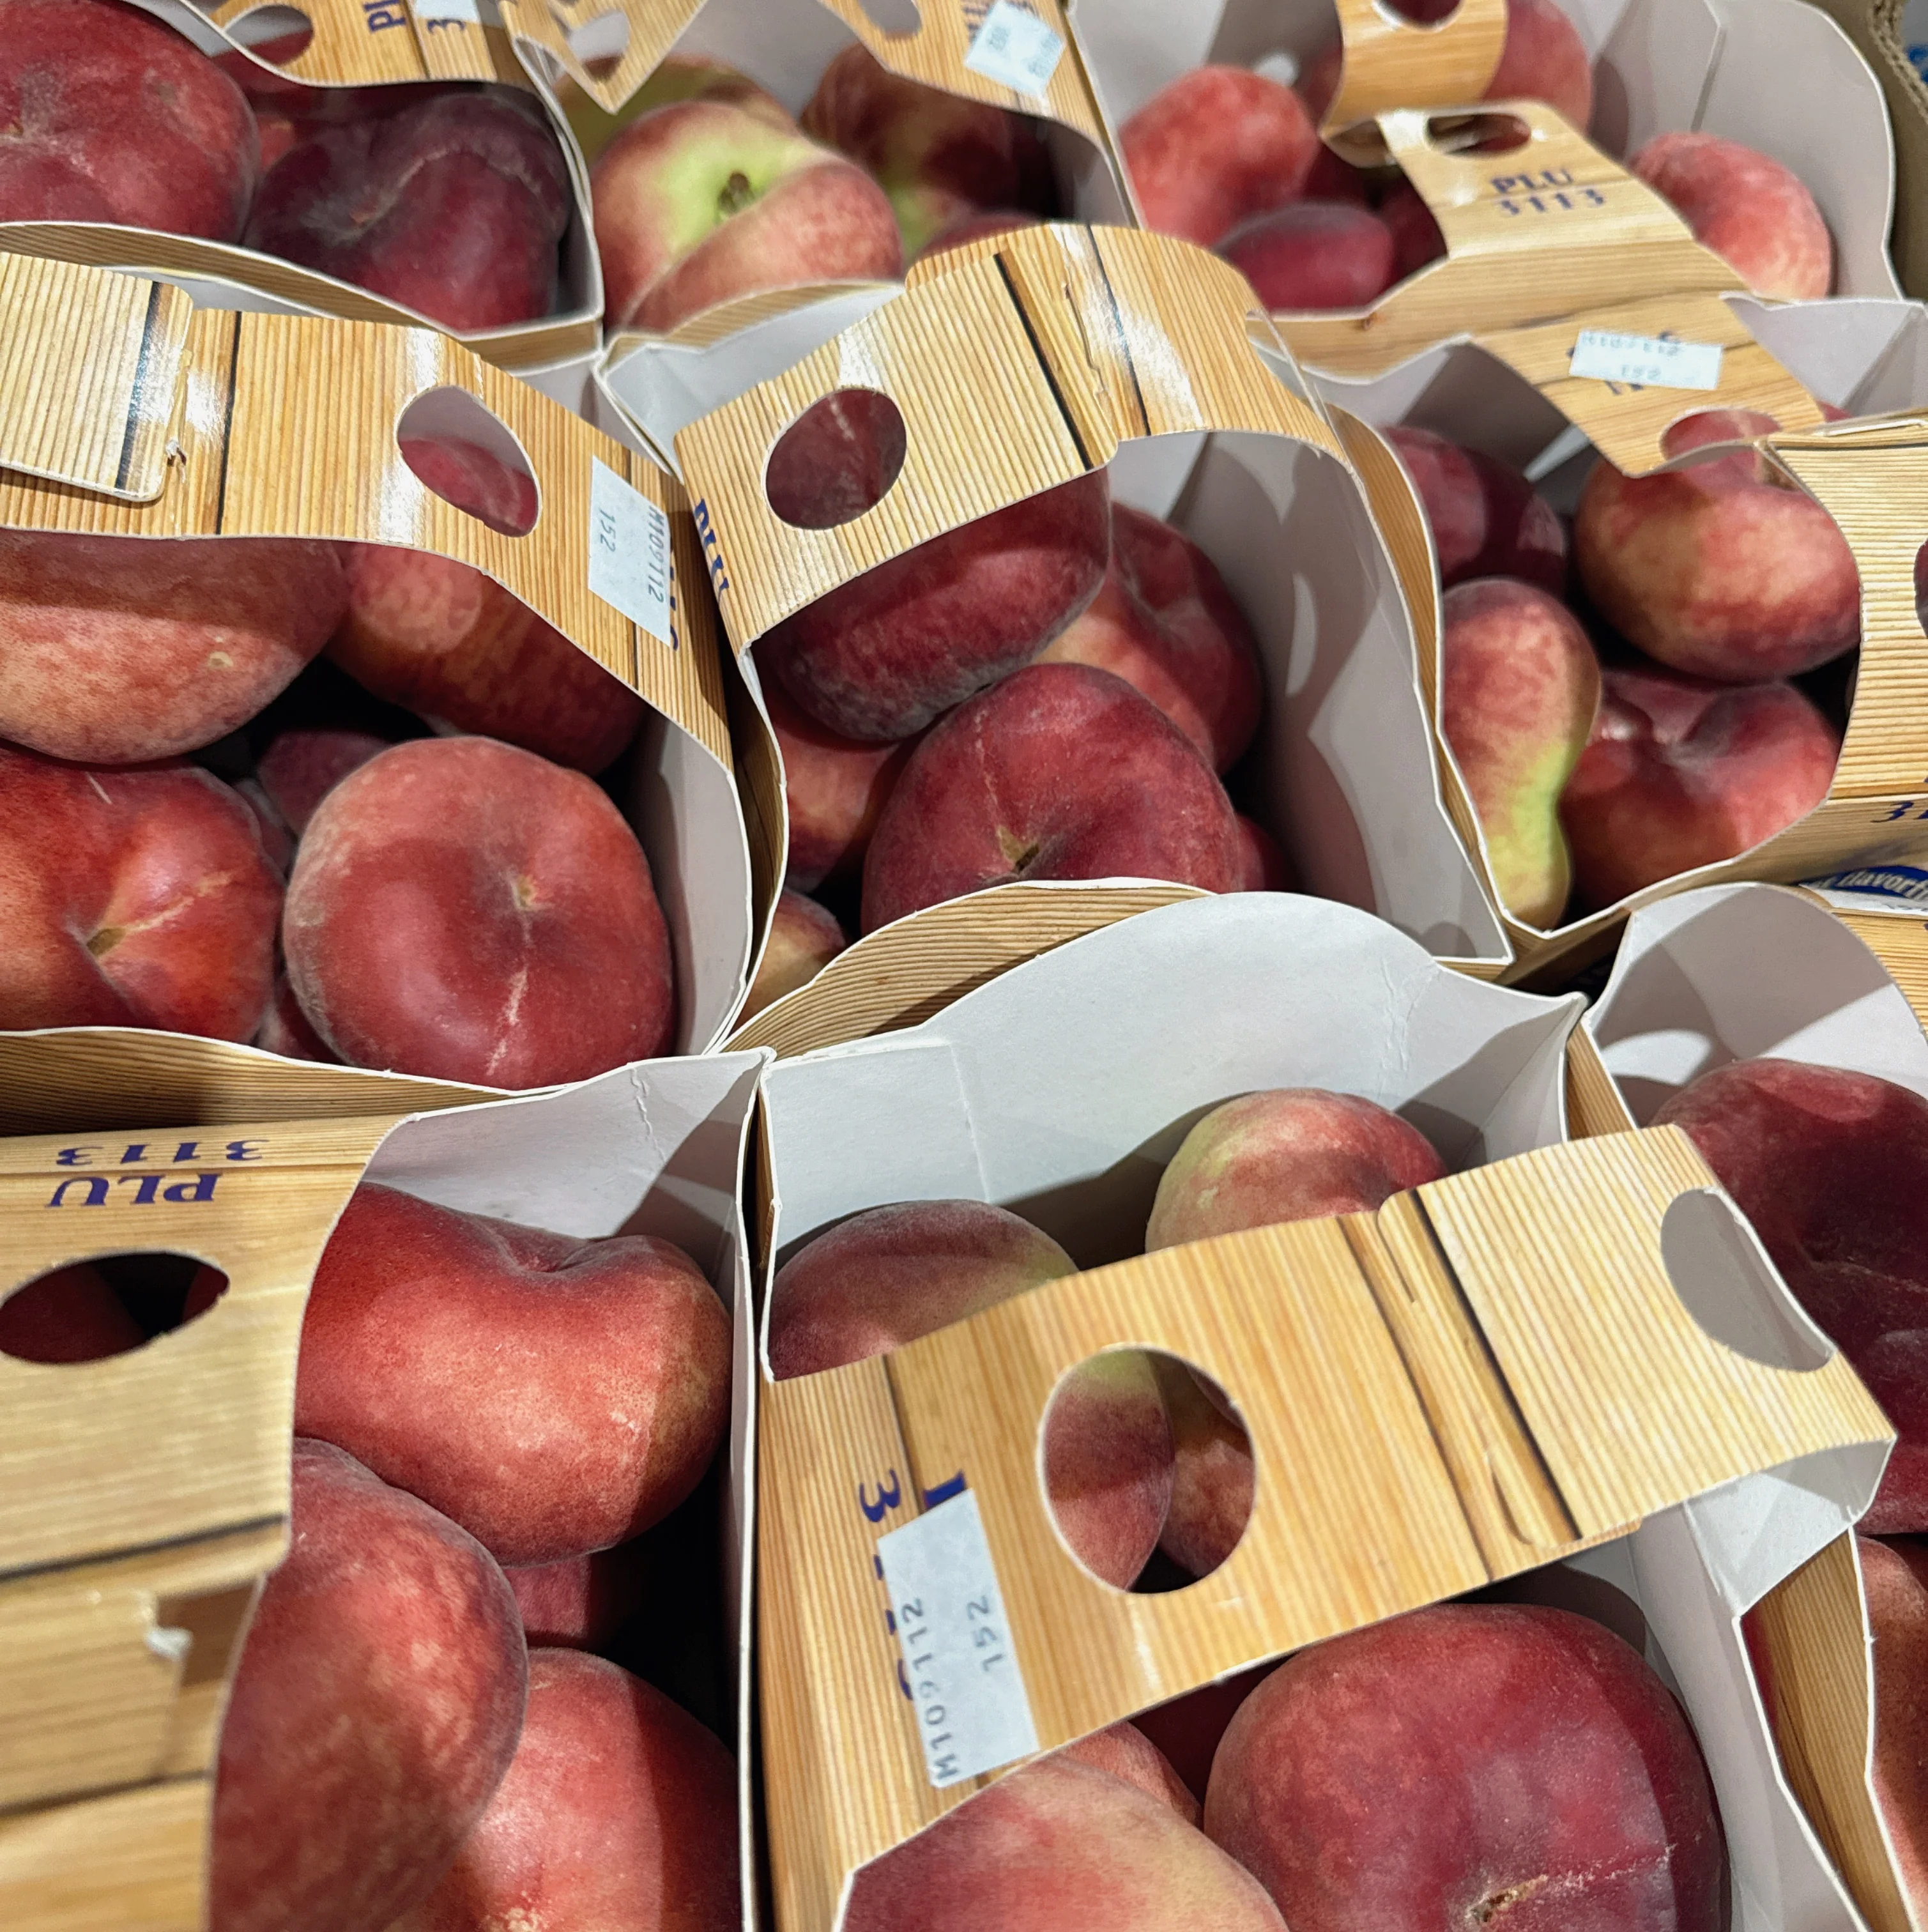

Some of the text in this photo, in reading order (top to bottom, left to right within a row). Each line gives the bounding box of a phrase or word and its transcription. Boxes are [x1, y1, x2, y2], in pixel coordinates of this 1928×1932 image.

[1492, 168, 1573, 194] PLU
[1501, 189, 1604, 215] 3113
[599, 507, 616, 553] 152
[648, 505, 665, 603] M109112
[56, 1139, 270, 1166] 3113
[45, 1172, 224, 1208] PLU
[966, 1595, 1007, 1673] 152
[901, 1597, 958, 1781] M109112
